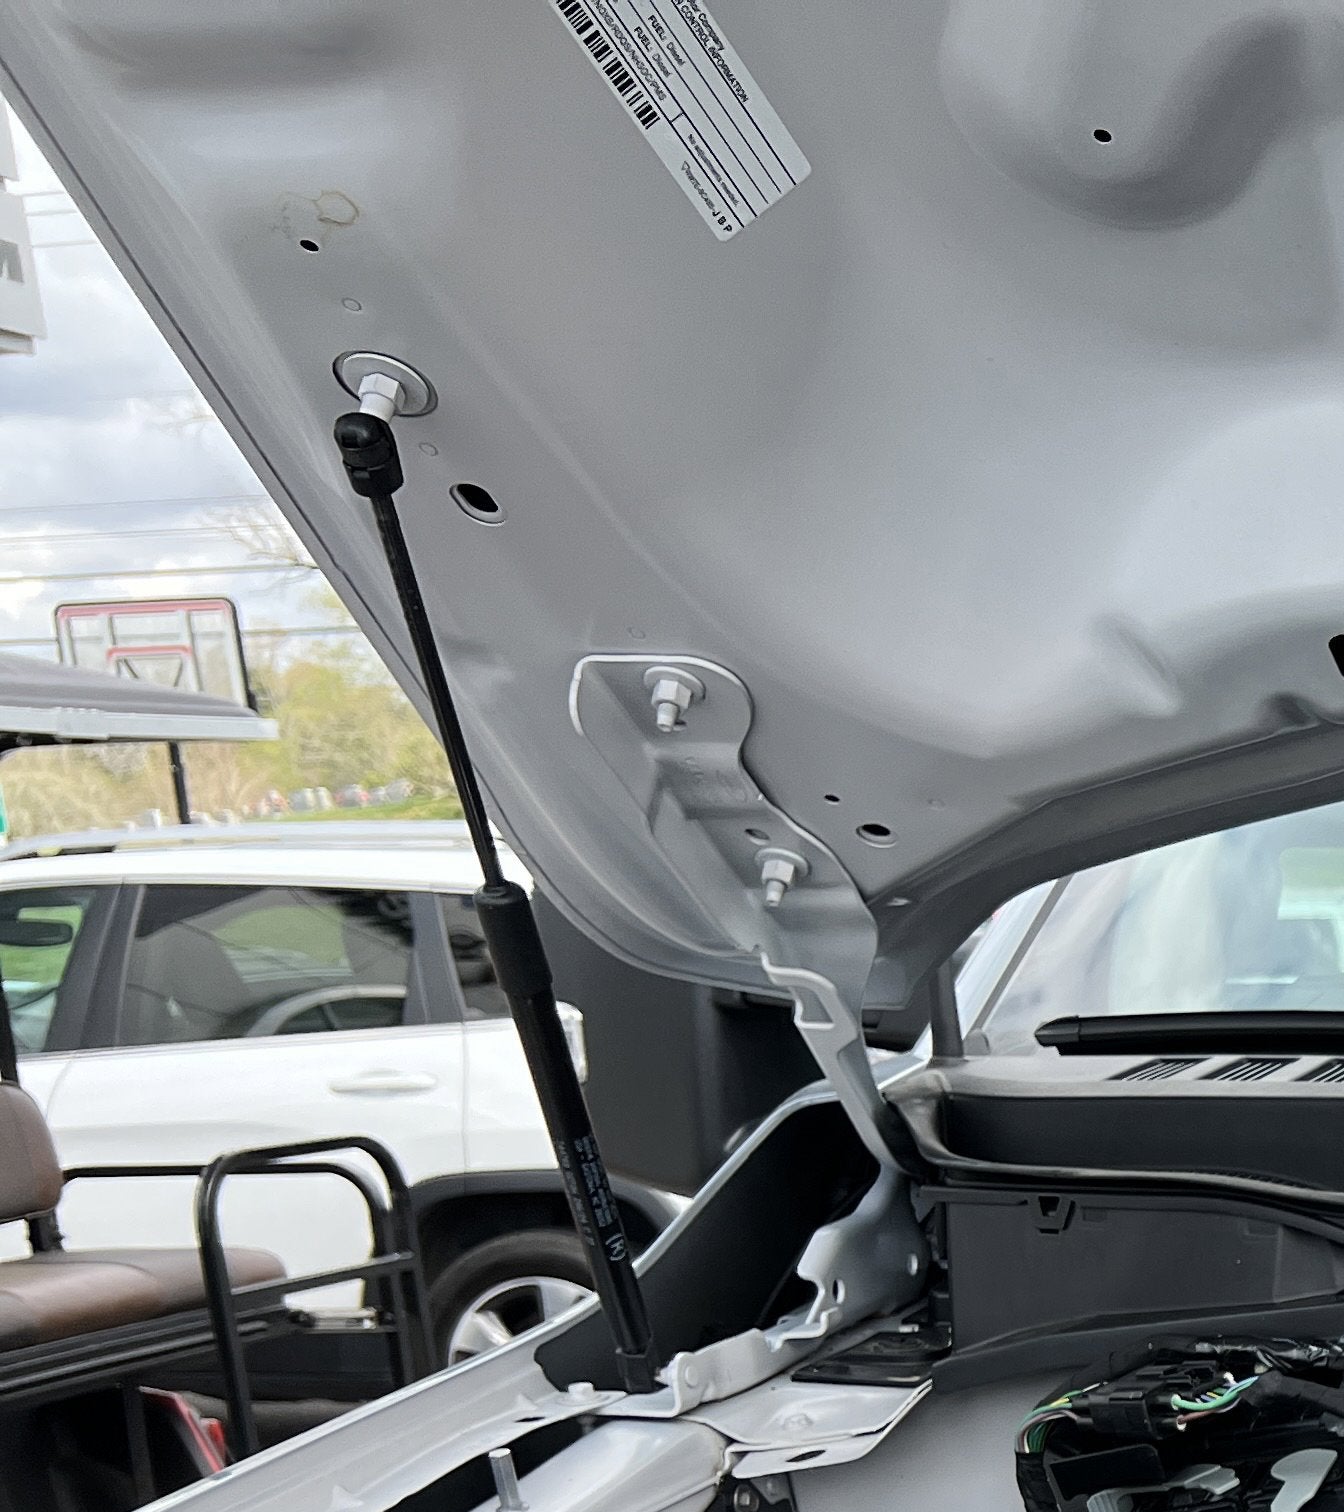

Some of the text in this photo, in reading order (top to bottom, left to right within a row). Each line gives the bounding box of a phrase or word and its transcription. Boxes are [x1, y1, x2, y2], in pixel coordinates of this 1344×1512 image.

[633, 26, 653, 53] FUEL:
[647, 14, 668, 42] FUEL:
[681, 5, 749, 102] CONTROL INFORMATION
